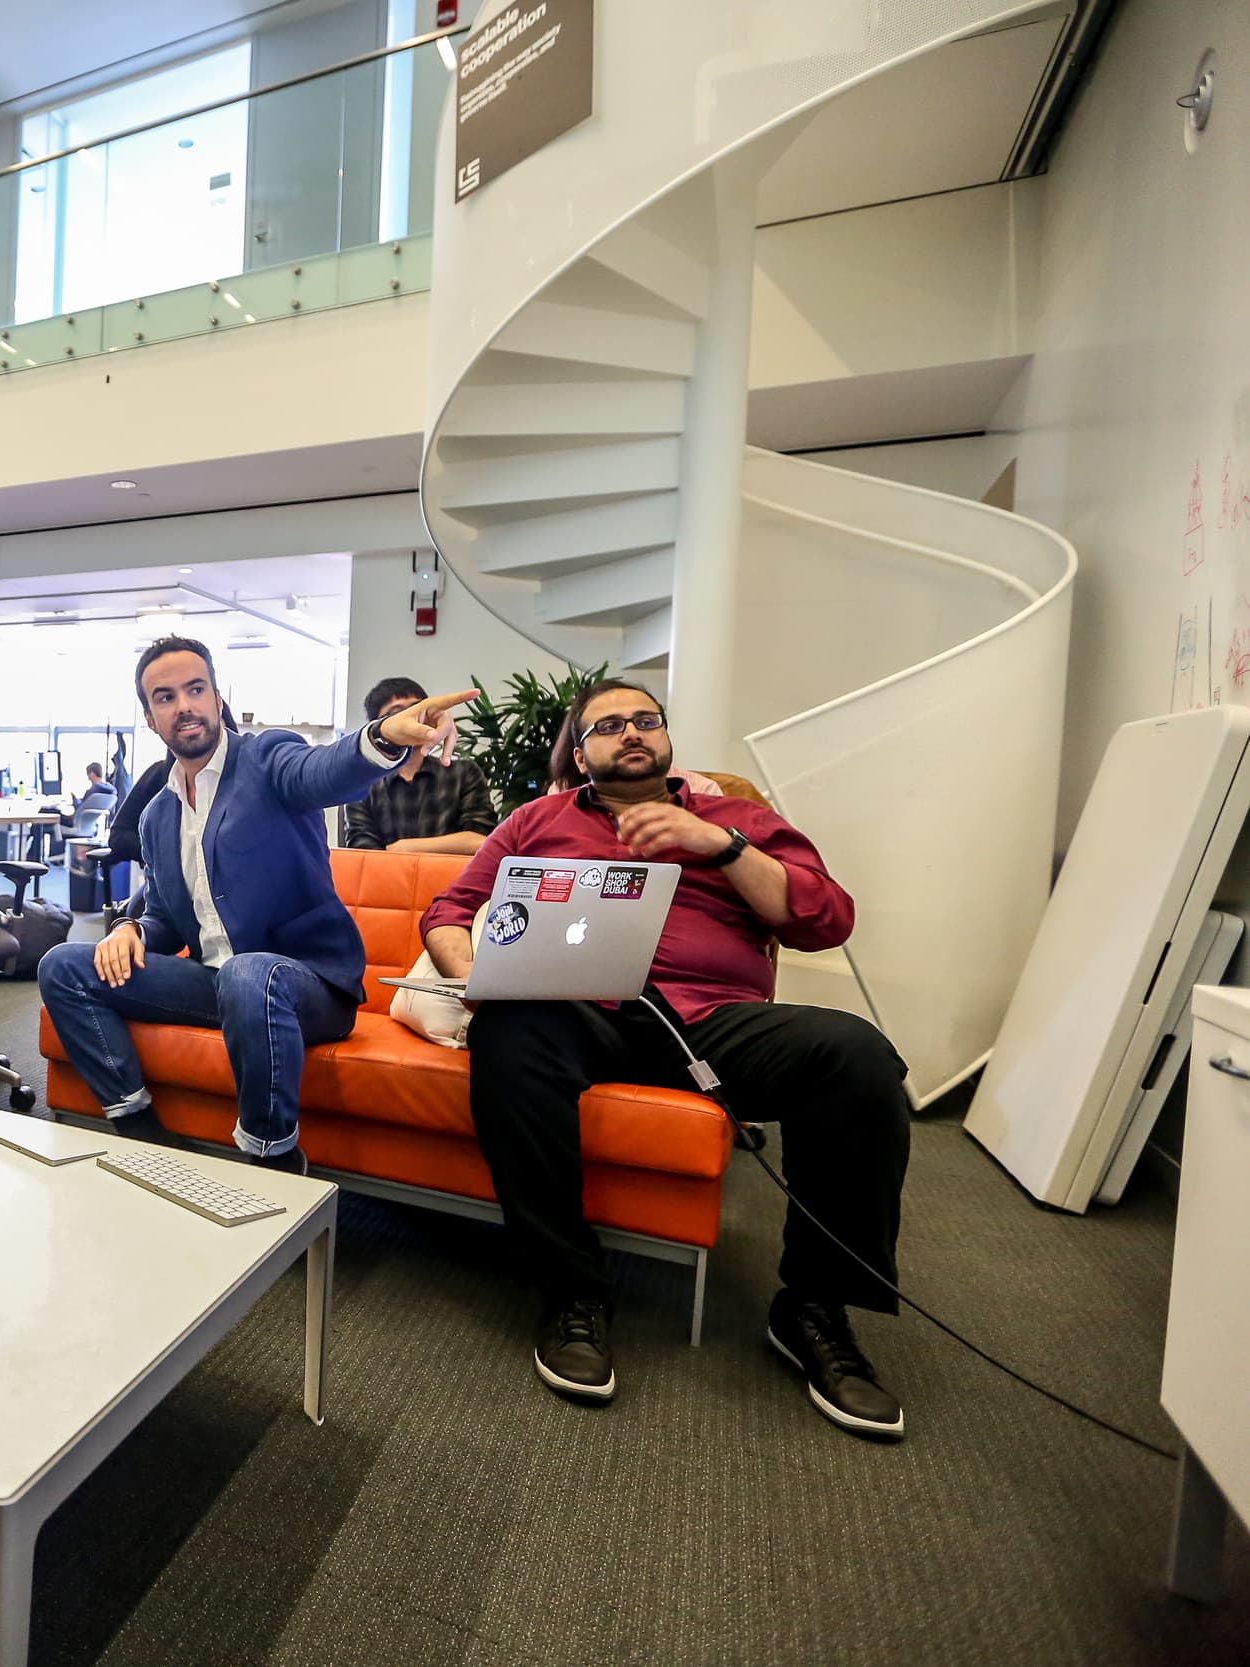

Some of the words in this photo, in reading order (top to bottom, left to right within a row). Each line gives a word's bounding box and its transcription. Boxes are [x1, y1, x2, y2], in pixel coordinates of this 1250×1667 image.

[460, 2, 547, 79] cooperation
[461, 8, 519, 62] scalable
[605, 879, 628, 887] SHOP
[607, 871, 632, 880] WORK
[603, 886, 629, 895] DUBAI
[494, 917, 525, 942] WORLD
